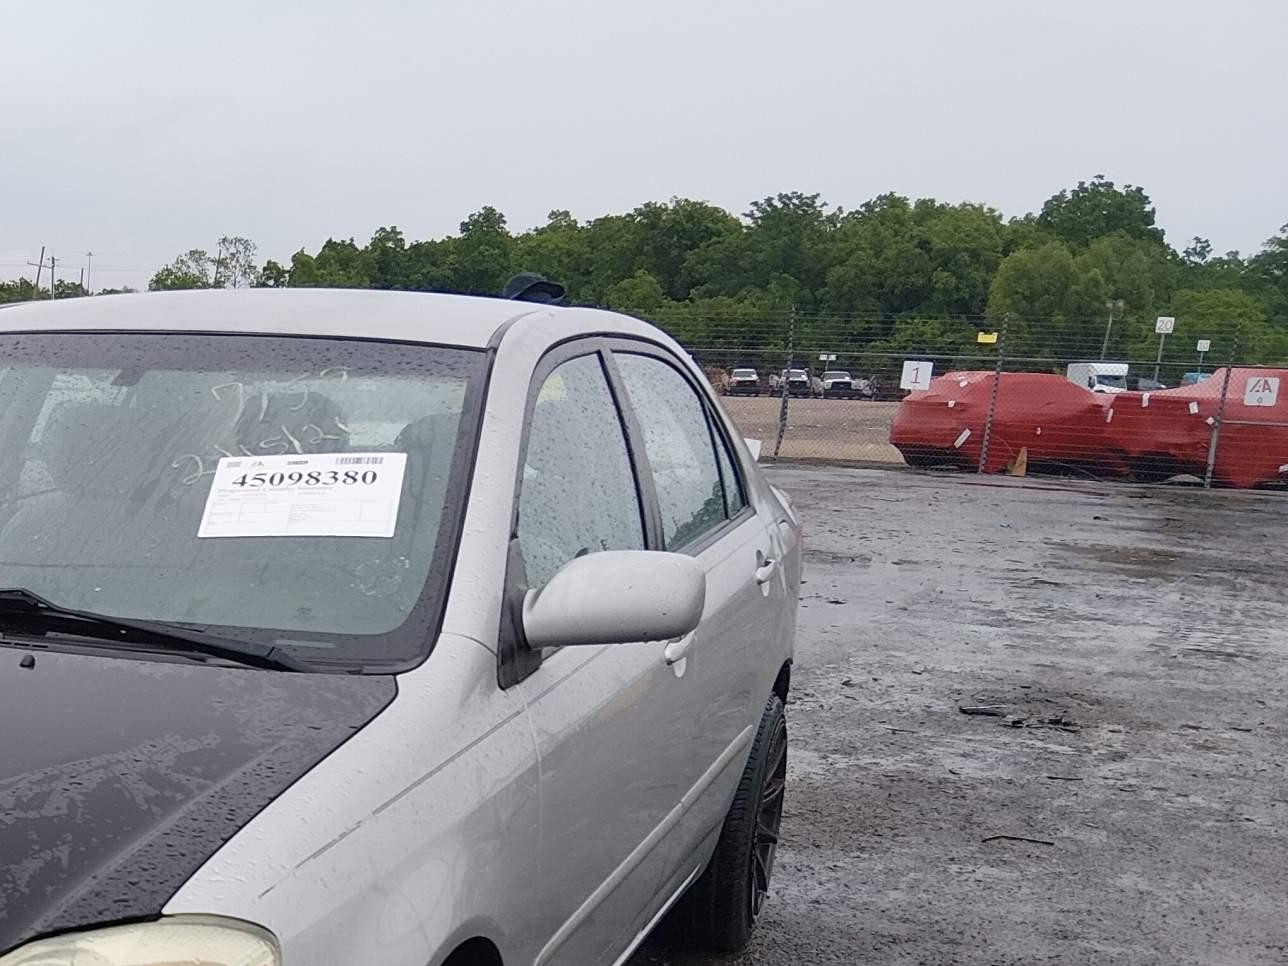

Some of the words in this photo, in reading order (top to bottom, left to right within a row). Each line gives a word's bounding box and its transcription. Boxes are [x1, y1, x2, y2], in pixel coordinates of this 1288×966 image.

[1158, 319, 1173, 331] 20
[911, 367, 921, 384] 1
[230, 470, 378, 488] 45098380
